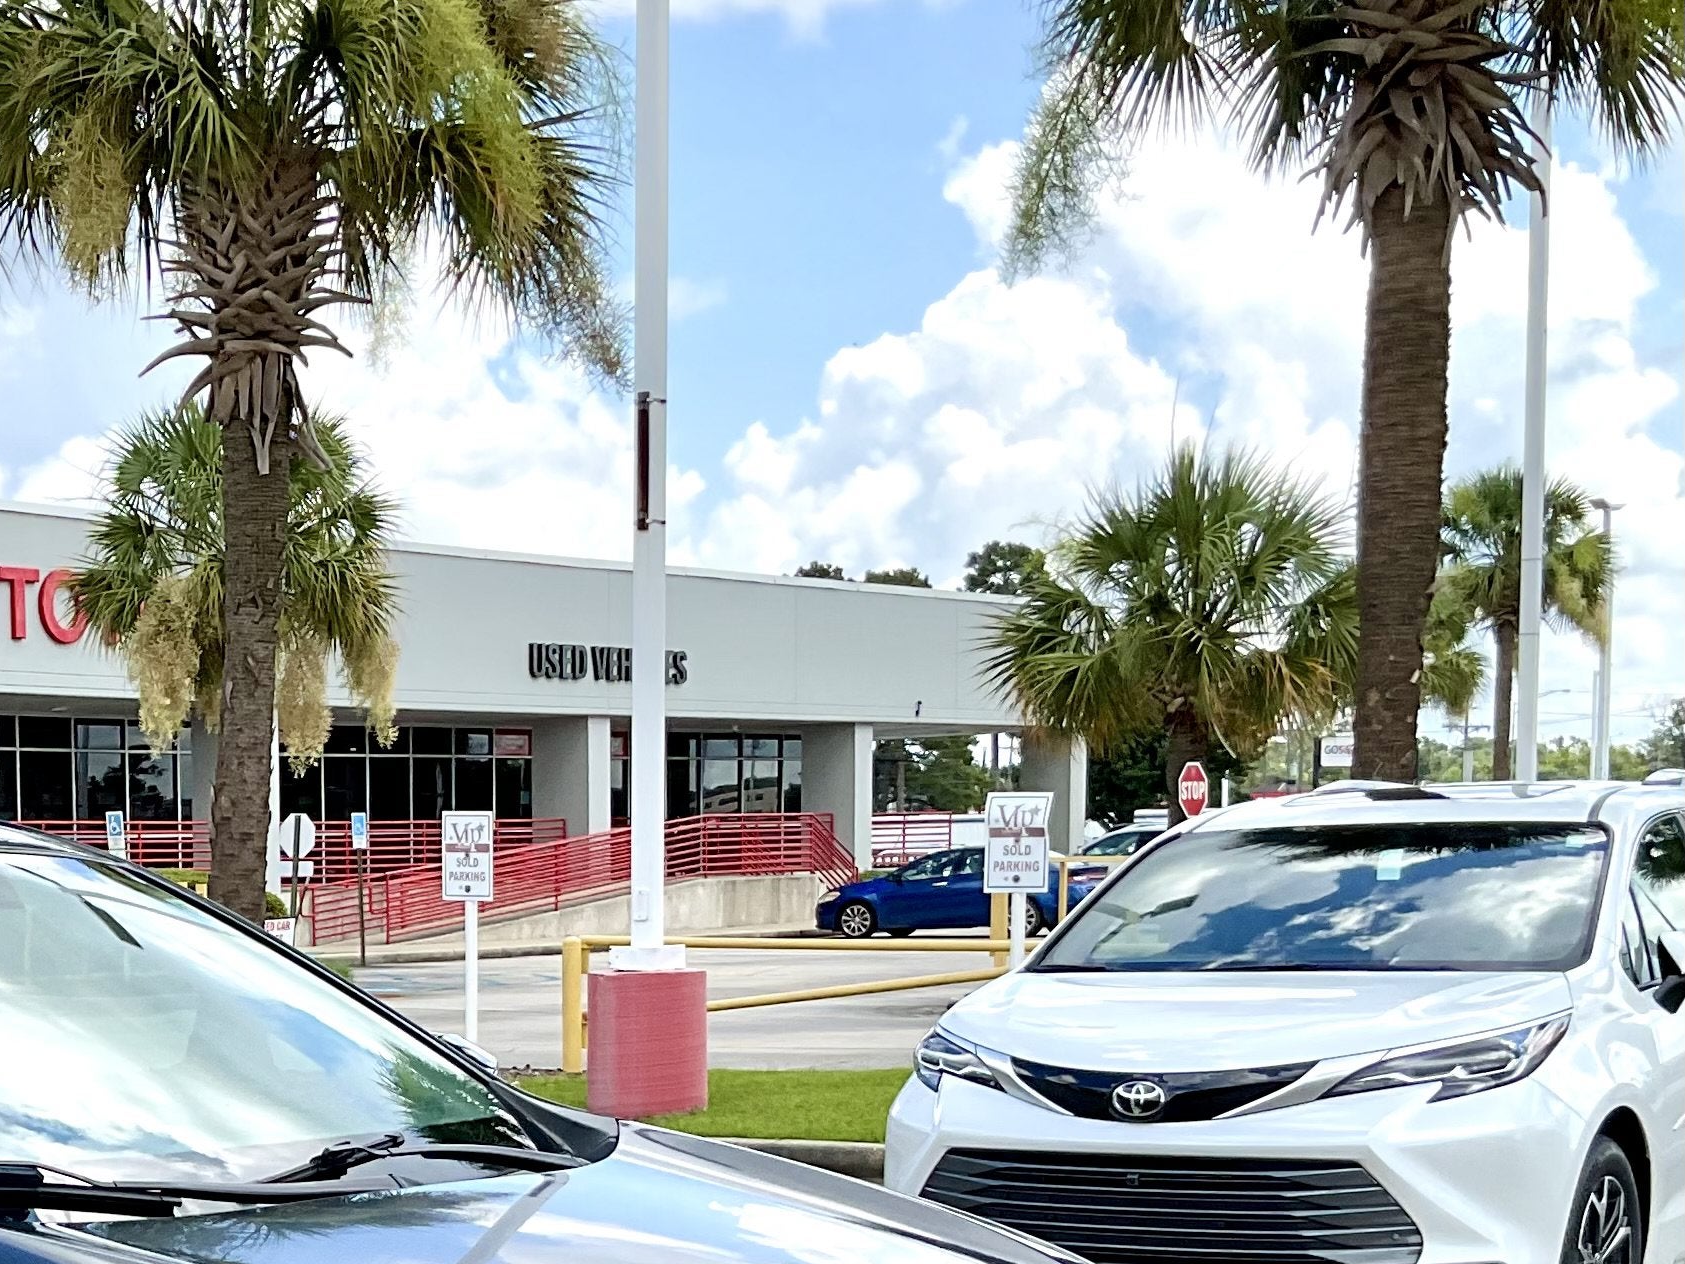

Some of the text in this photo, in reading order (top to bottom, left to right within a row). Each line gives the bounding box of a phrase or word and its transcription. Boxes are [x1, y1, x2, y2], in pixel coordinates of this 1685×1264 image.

[528, 642, 688, 685] USED VEHES
[1181, 780, 1205, 801] STOP
[1002, 844, 1032, 856] SOLD
[456, 857, 479, 868] SOLD
[993, 860, 1040, 873] PARKING
[448, 871, 486, 882] PARKING
